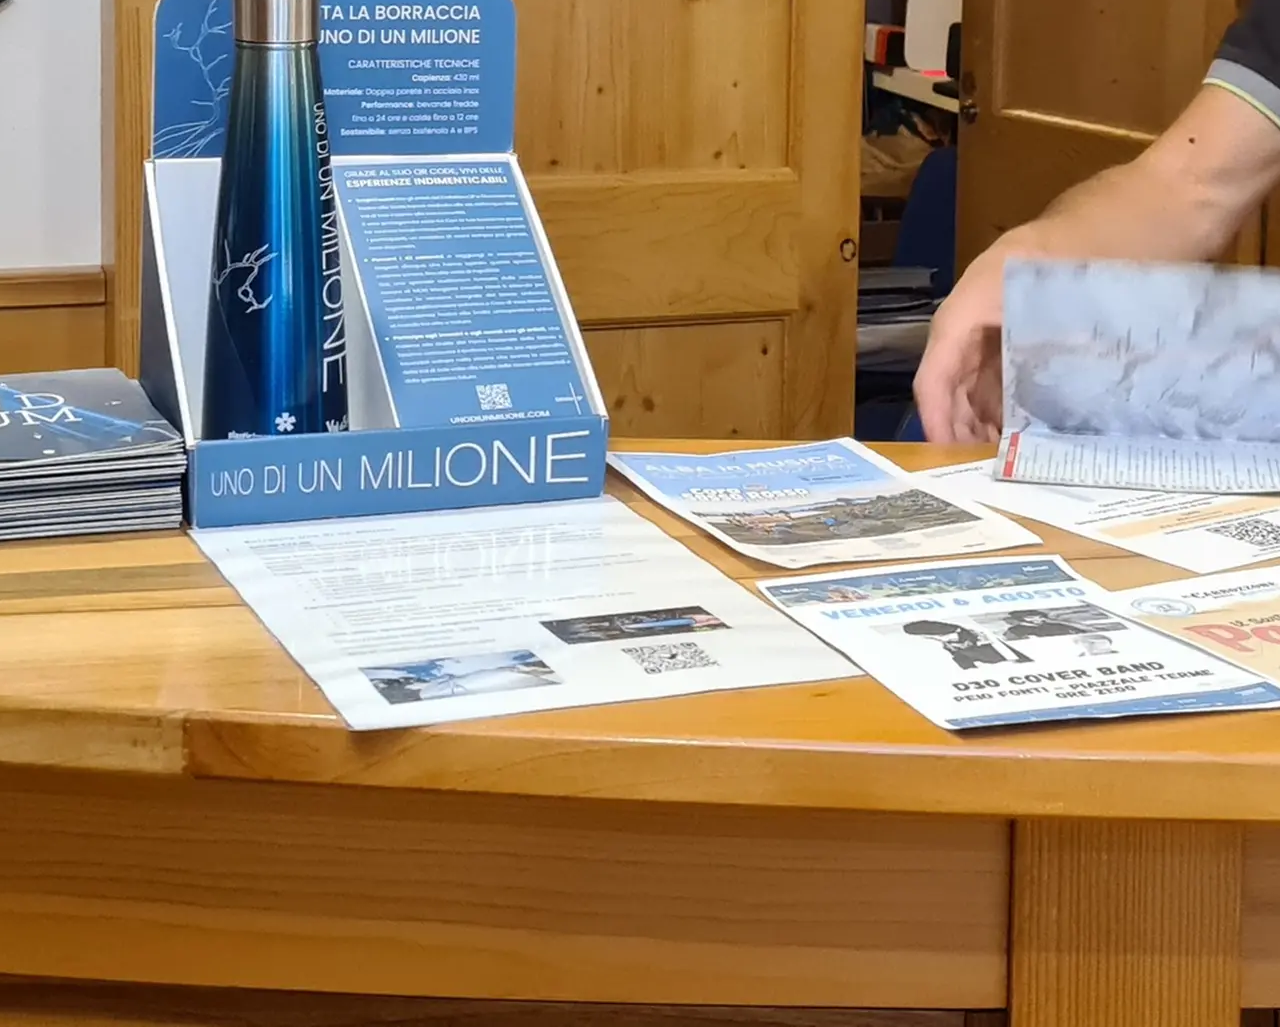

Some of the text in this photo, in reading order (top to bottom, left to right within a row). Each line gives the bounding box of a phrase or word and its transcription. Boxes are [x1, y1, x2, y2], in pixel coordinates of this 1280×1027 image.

[349, 5, 370, 20] LA
[375, 5, 481, 20] BORRACCIA
[357, 29, 375, 44] DI
[380, 29, 406, 44] UN
[410, 29, 481, 44] MILIONE
[348, 59, 480, 69] CARATTERISTICHE TECNICHE
[346, 176, 508, 188] ESPERIENZE INDIMENTICABILI
[313, 102, 347, 393] UNO DI UN MILIONE
[211, 430, 590, 496] UNO DI UN MILIONE
[645, 462, 713, 474] ALBA
[745, 454, 845, 472] MUSICA
[820, 586, 1087, 620] VENERDÌ 6 AGOSTO
[953, 661, 1165, 692] D30 COVER BAND
[953, 669, 1215, 703] PEIO FONTI PIAZZALE TERME
[1055, 689, 1095, 699] ORE
